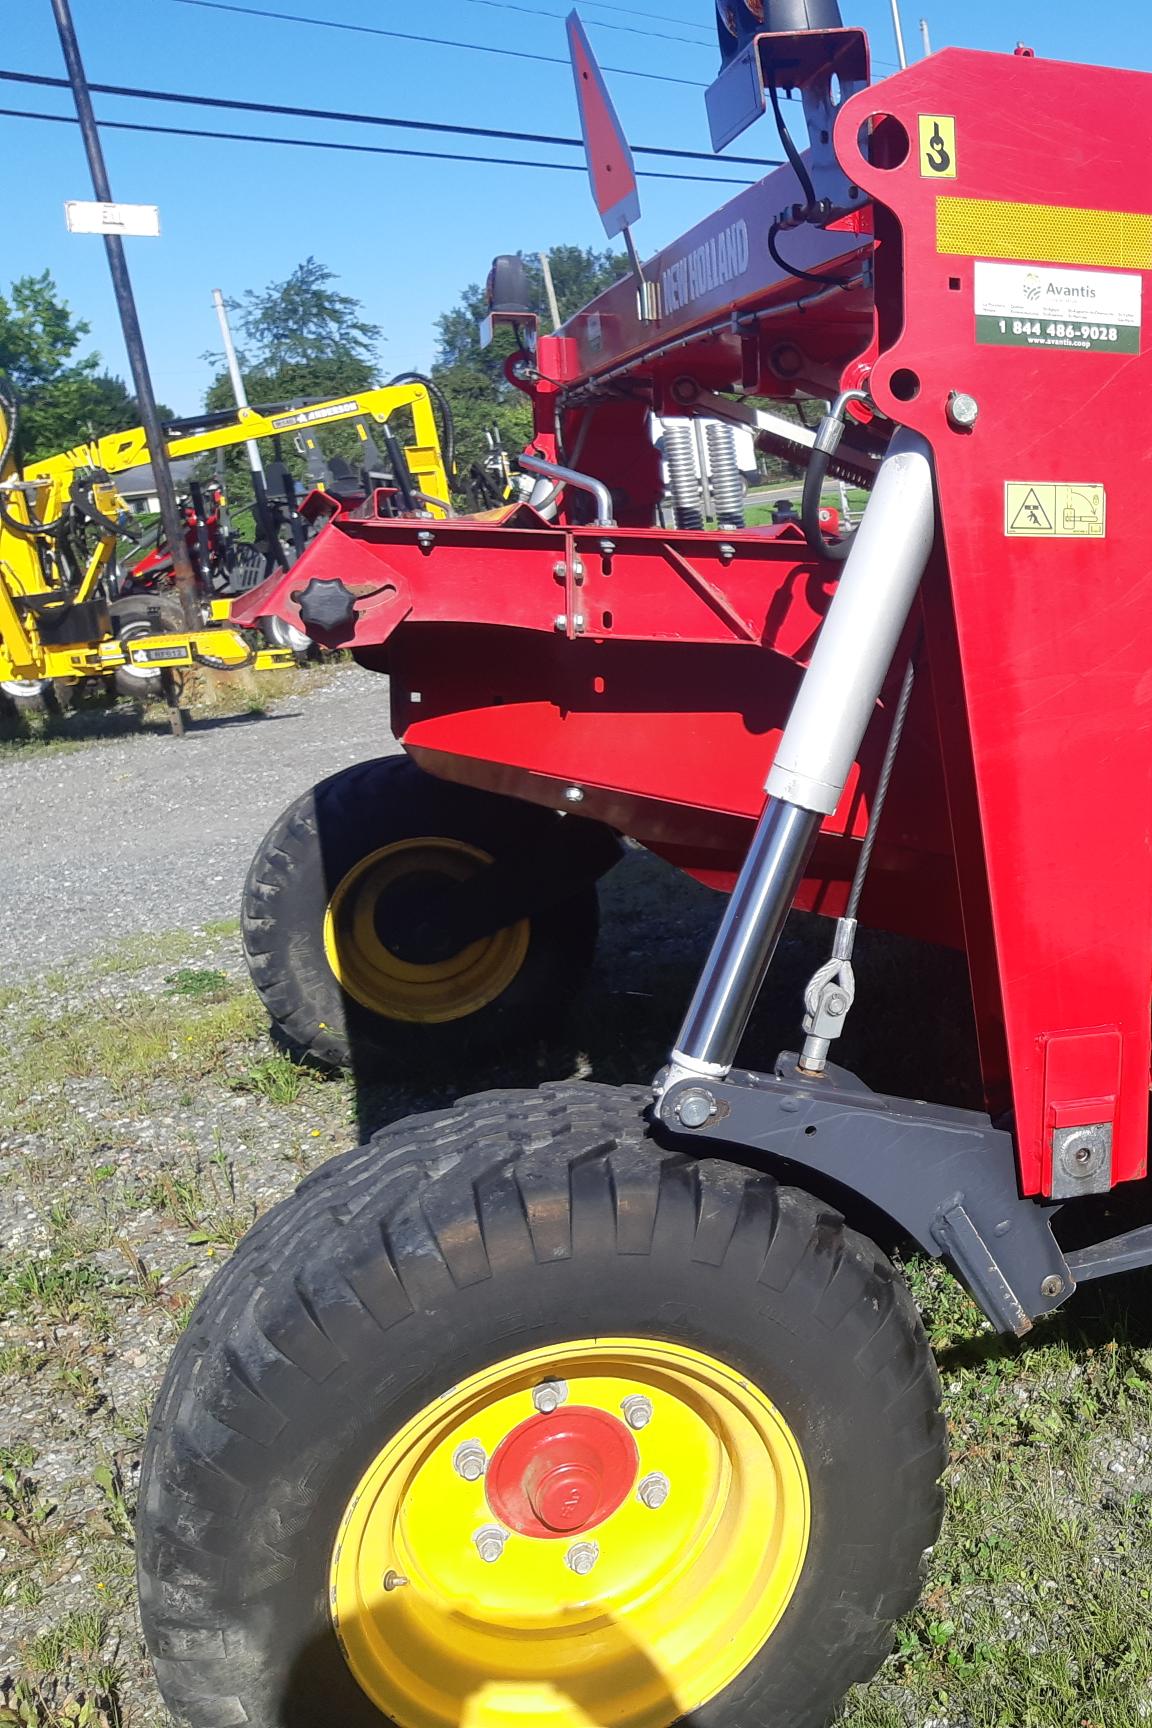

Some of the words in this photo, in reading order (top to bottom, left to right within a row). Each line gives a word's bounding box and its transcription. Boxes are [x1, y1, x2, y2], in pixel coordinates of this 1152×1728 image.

[663, 256, 689, 316] NEW
[688, 218, 749, 301] HOLLAND
[1046, 282, 1097, 299] Avantis
[999, 320, 1006, 334] 1
[1012, 321, 1041, 336] 844
[1046, 323, 1118, 341] 486-9028
[1027, 337, 1091, 349] www.avantis.coop
[308, 401, 359, 421] ANDERSON
